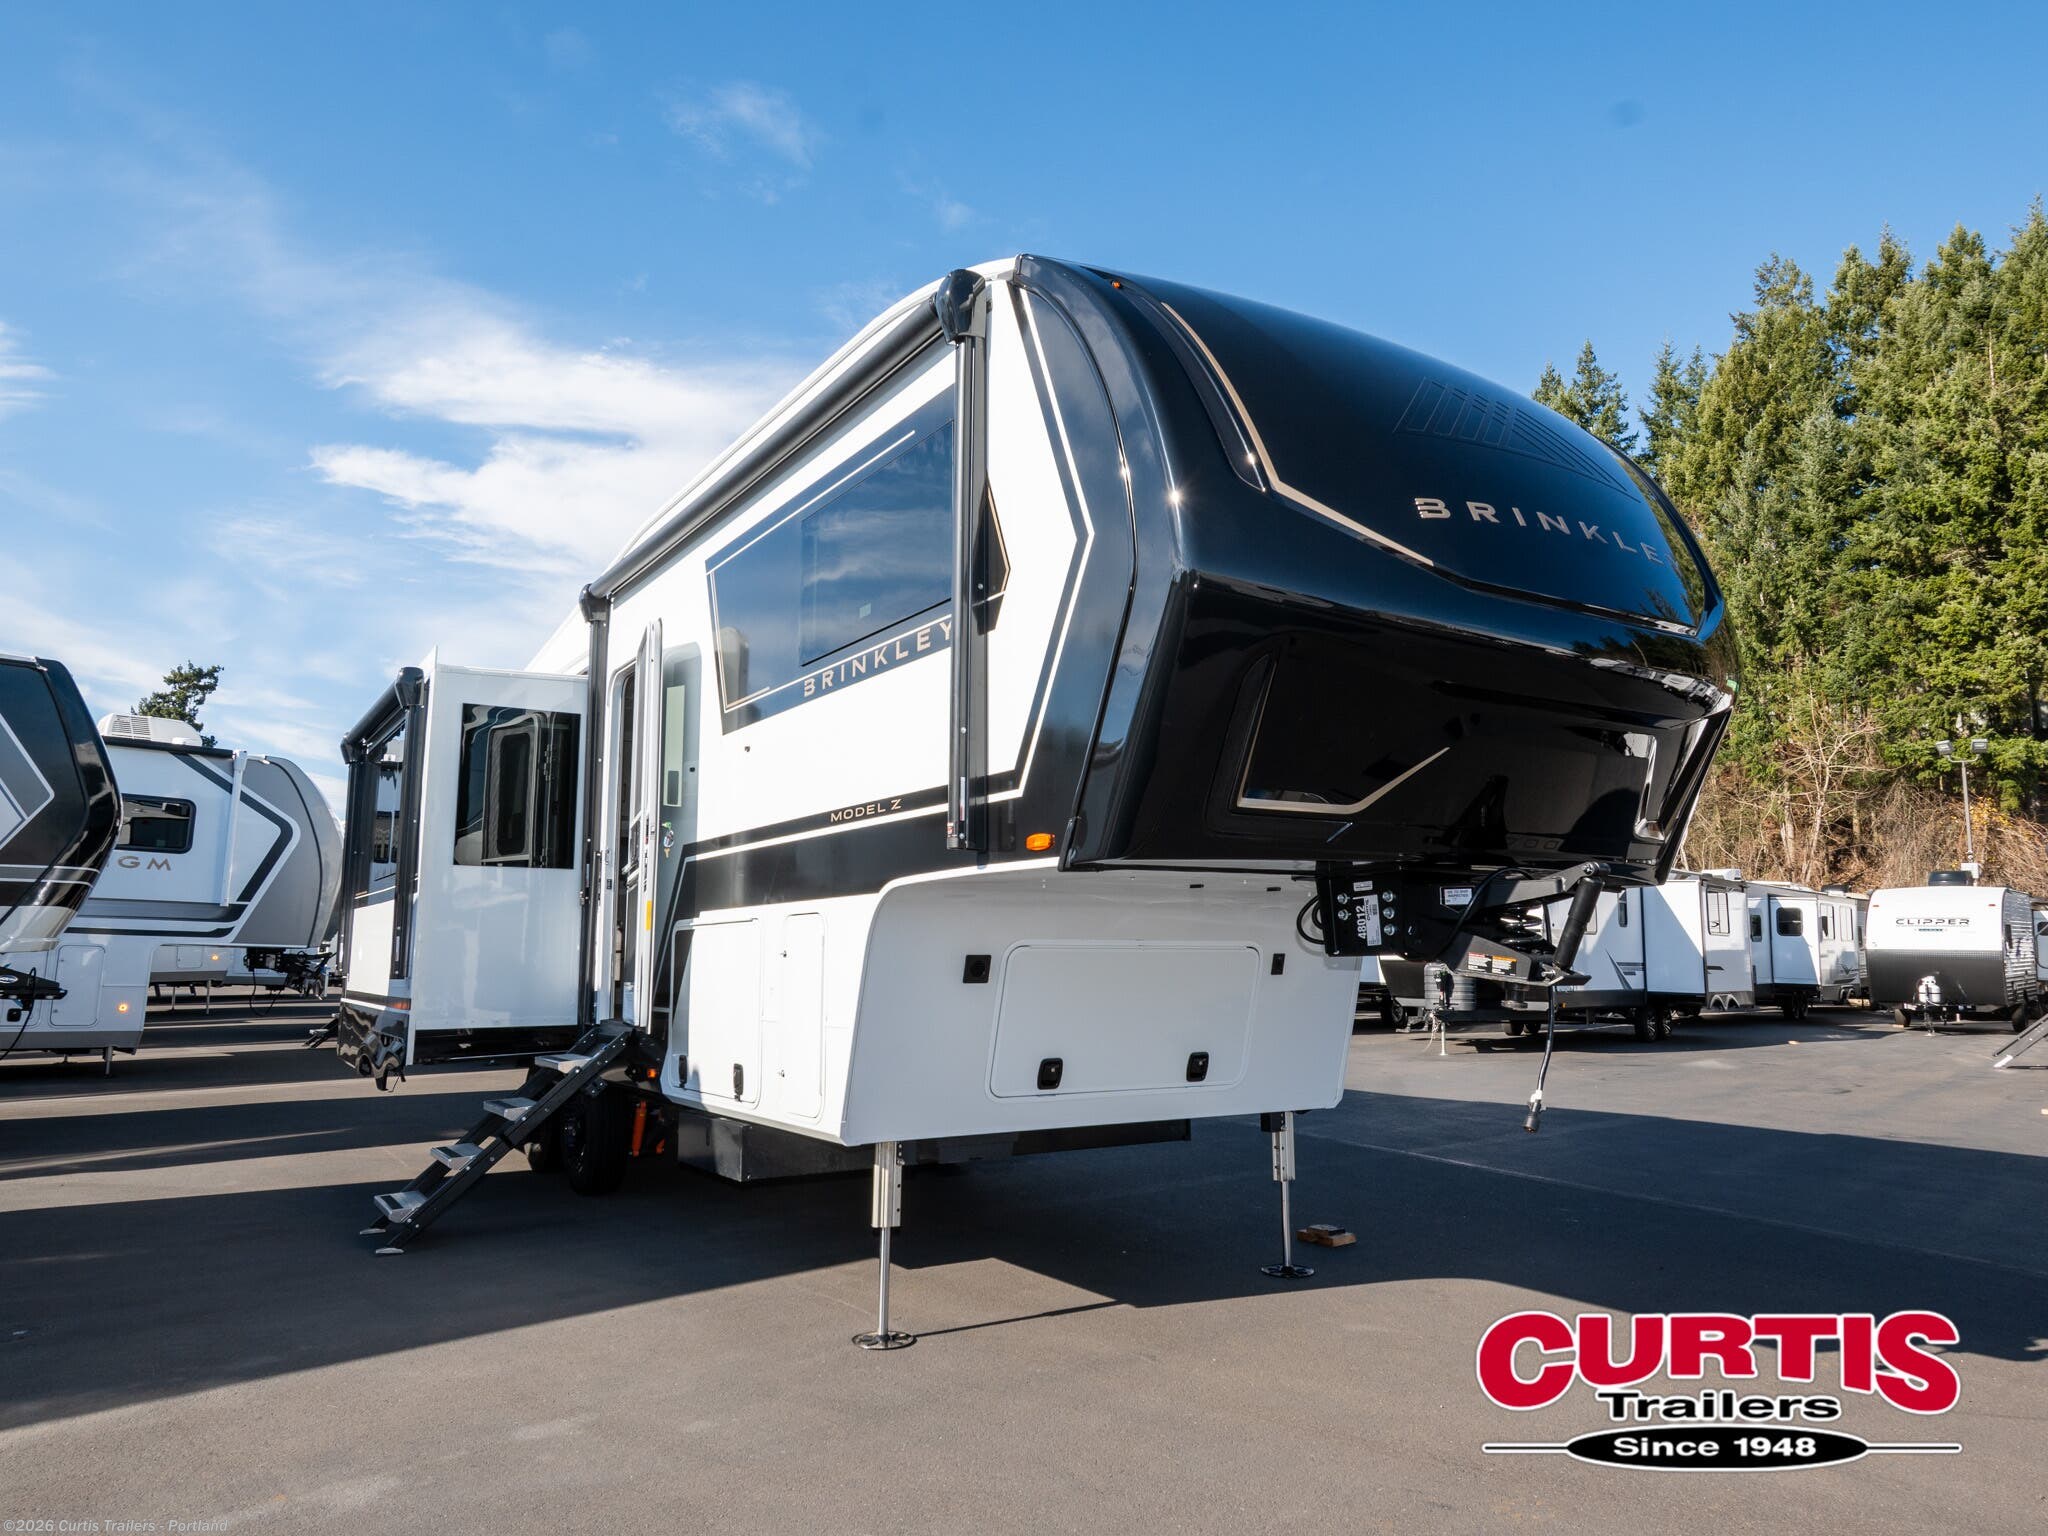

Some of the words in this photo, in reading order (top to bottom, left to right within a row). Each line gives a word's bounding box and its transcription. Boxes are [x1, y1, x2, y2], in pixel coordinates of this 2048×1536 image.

[1414, 497, 1676, 568] BRINKLE
[804, 621, 952, 697] BRINKLEY
[830, 803, 886, 823] MODEL
[890, 798, 903, 811] Z
[106, 855, 172, 872] GM
[1356, 905, 1367, 939] 48012
